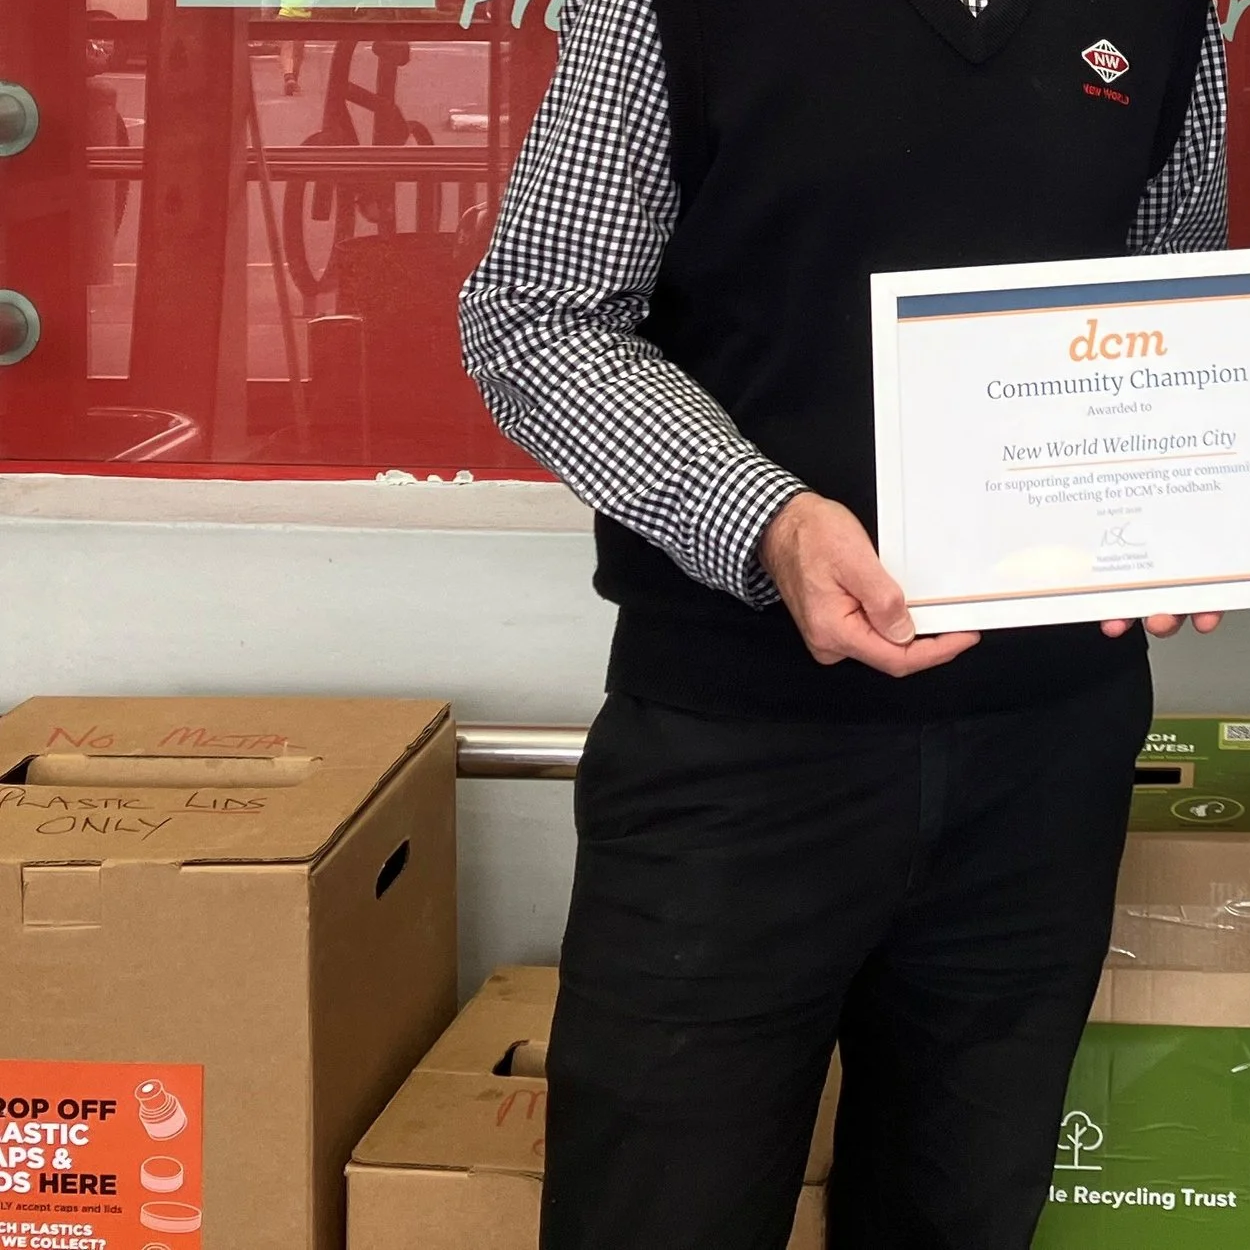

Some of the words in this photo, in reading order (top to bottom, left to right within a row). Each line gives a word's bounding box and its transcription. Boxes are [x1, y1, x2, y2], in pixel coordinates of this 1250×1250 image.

[1093, 51, 1120, 70] NW
[1068, 318, 1168, 362] dcm
[986, 371, 1124, 400] Community
[1130, 363, 1249, 390] Champion
[1087, 402, 1138, 417] Awarded
[1140, 402, 1153, 413] to
[1002, 444, 1043, 462] New
[1046, 438, 1099, 458] World
[1103, 432, 1198, 456] Wellington
[1202, 428, 1238, 450] City
[985, 480, 1003, 492] for
[1005, 473, 1070, 492] supporting
[1073, 472, 1095, 485] and
[1097, 467, 1170, 486] empowering
[1172, 467, 1193, 479] our
[1028, 492, 1043, 507] by
[1045, 487, 1103, 504] collecting
[1105, 486, 1122, 499] for
[1165, 479, 1222, 495] foodbank
[1141, 743, 1195, 753] IVES!
[35, 815, 173, 842] ONLY
[57, 1098, 117, 1121] OFF
[0, 1121, 89, 1146] ASTIC
[52, 1147, 73, 1170] &
[39, 1172, 117, 1195] HERE
[16, 1203, 51, 1214] accept
[54, 1204, 79, 1214] caps
[81, 1203, 101, 1214] and
[104, 1203, 123, 1215] lids
[1073, 1185, 1176, 1211] Recycling
[1181, 1188, 1238, 1208] Trust
[21, 1222, 93, 1237] PLASTICS
[2, 1236, 28, 1248] WE
[30, 1236, 107, 1250] COLLECT?
